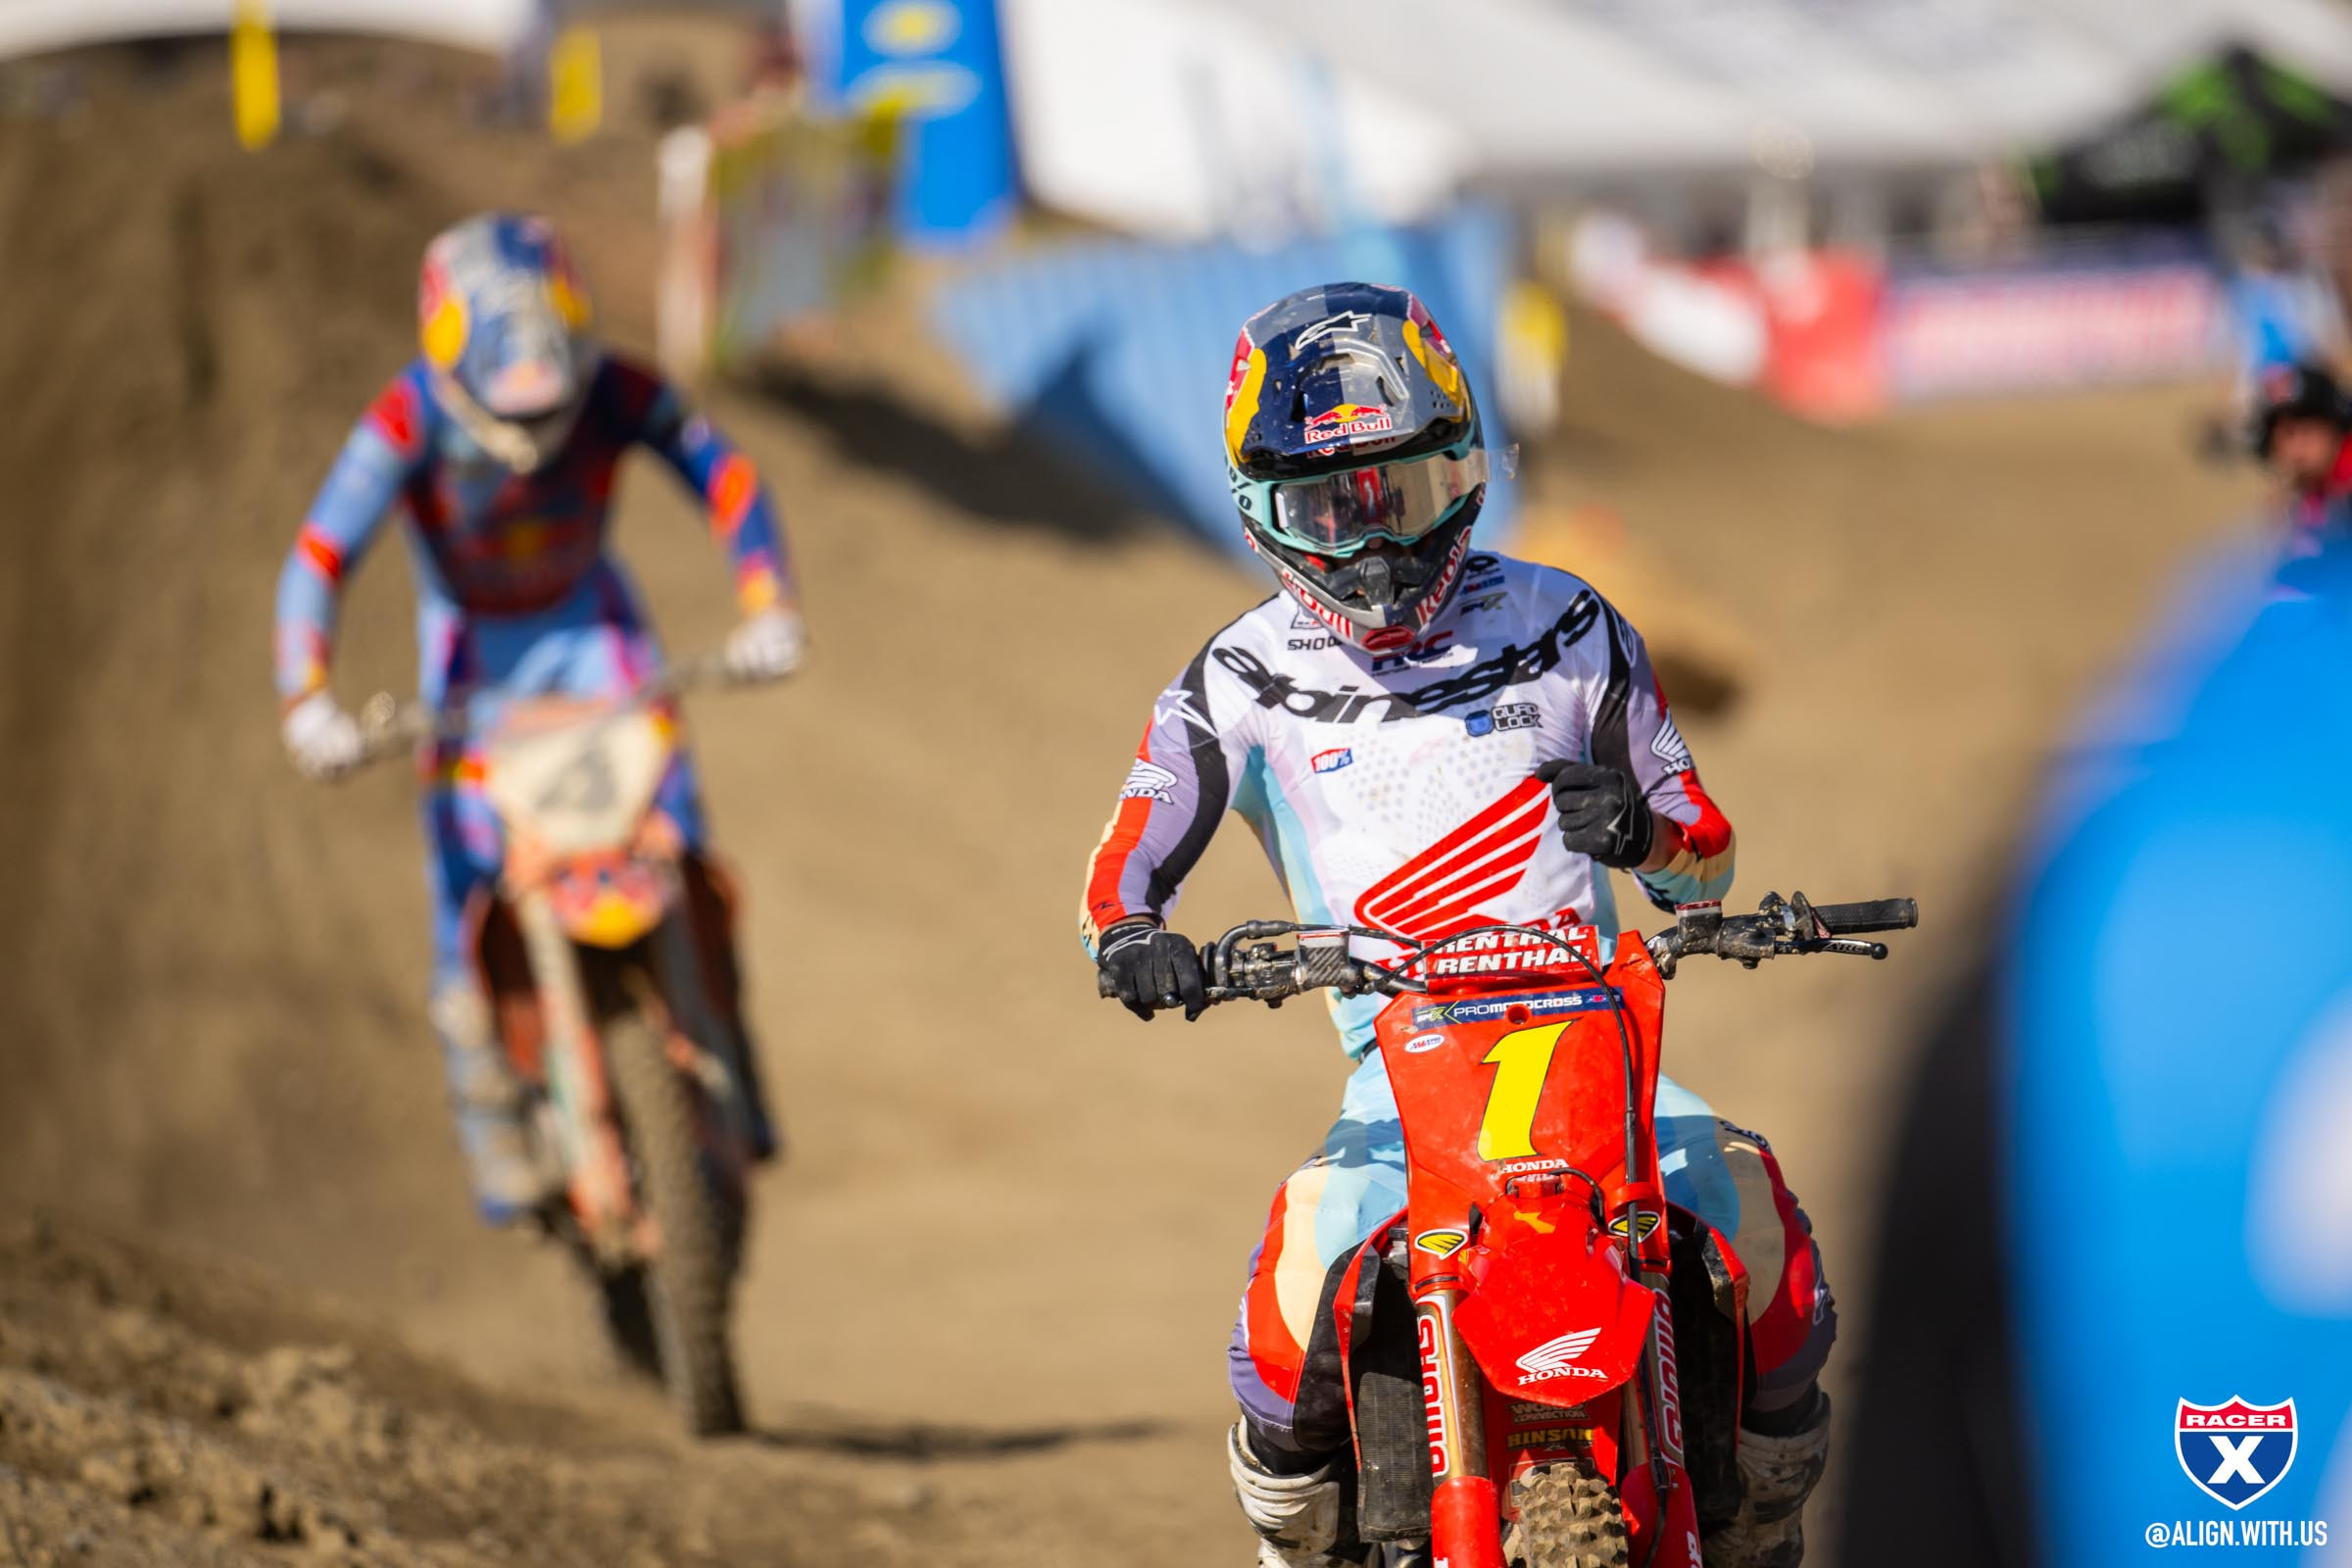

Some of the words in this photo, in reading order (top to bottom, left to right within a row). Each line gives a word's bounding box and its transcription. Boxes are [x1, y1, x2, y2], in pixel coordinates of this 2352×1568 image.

[1304, 422, 1348, 444] Red
[1349, 417, 1393, 433] Bull
[1212, 589, 1599, 724] alpinestars
[1491, 703, 1539, 720] QUAD
[1494, 715, 1543, 731] LOCK
[1314, 750, 1351, 772] 100%
[1435, 926, 1590, 955] RENTHAL
[1436, 945, 1590, 975] RENTHAL
[1478, 1019, 1576, 1162] 1
[1502, 1158, 1570, 1174] HONDA
[1517, 1367, 1608, 1387] HONDA
